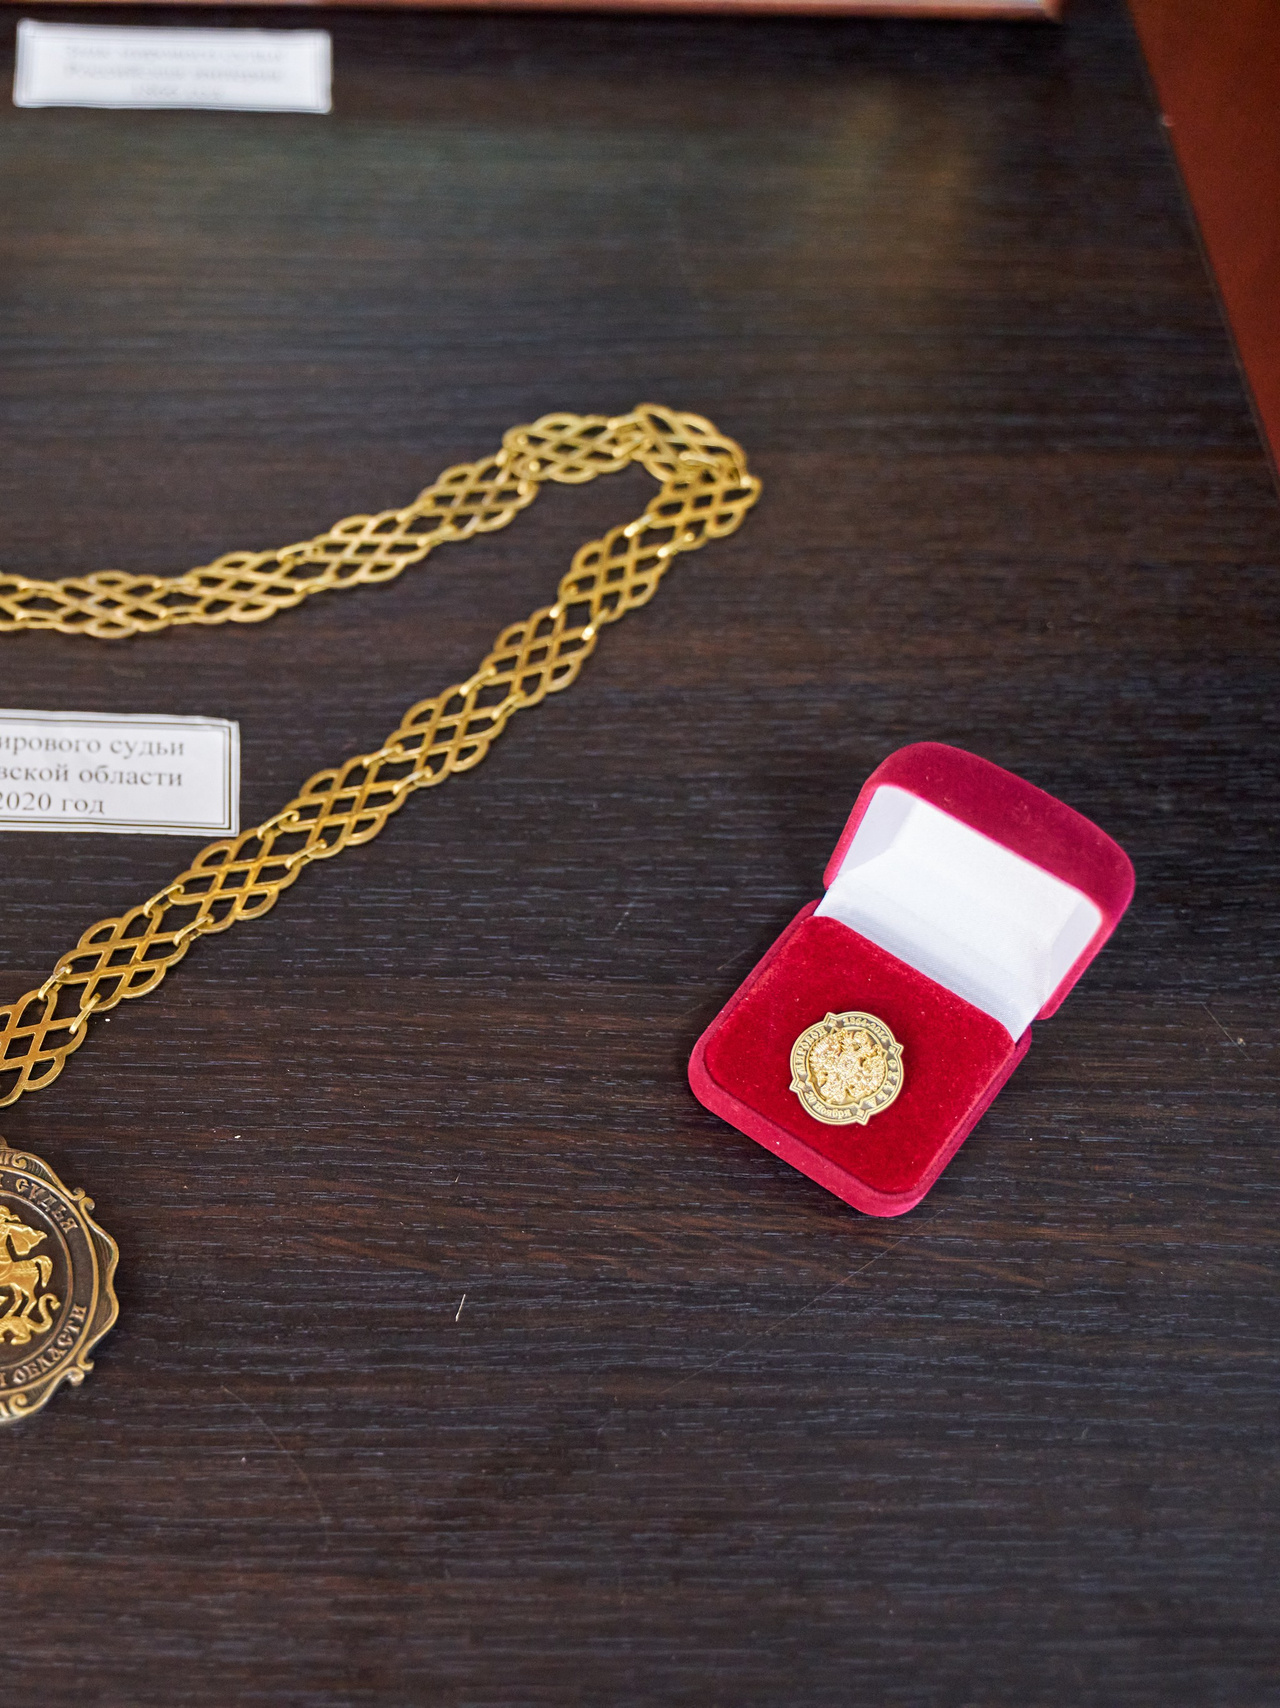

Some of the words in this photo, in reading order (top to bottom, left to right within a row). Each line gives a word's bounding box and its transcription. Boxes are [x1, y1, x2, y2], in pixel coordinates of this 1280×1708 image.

[109, 740, 185, 759] судьи
[78, 766, 183, 787] области
[61, 798, 105, 815] год
[12, 1304, 88, 1385] ОБЛАСТИ
